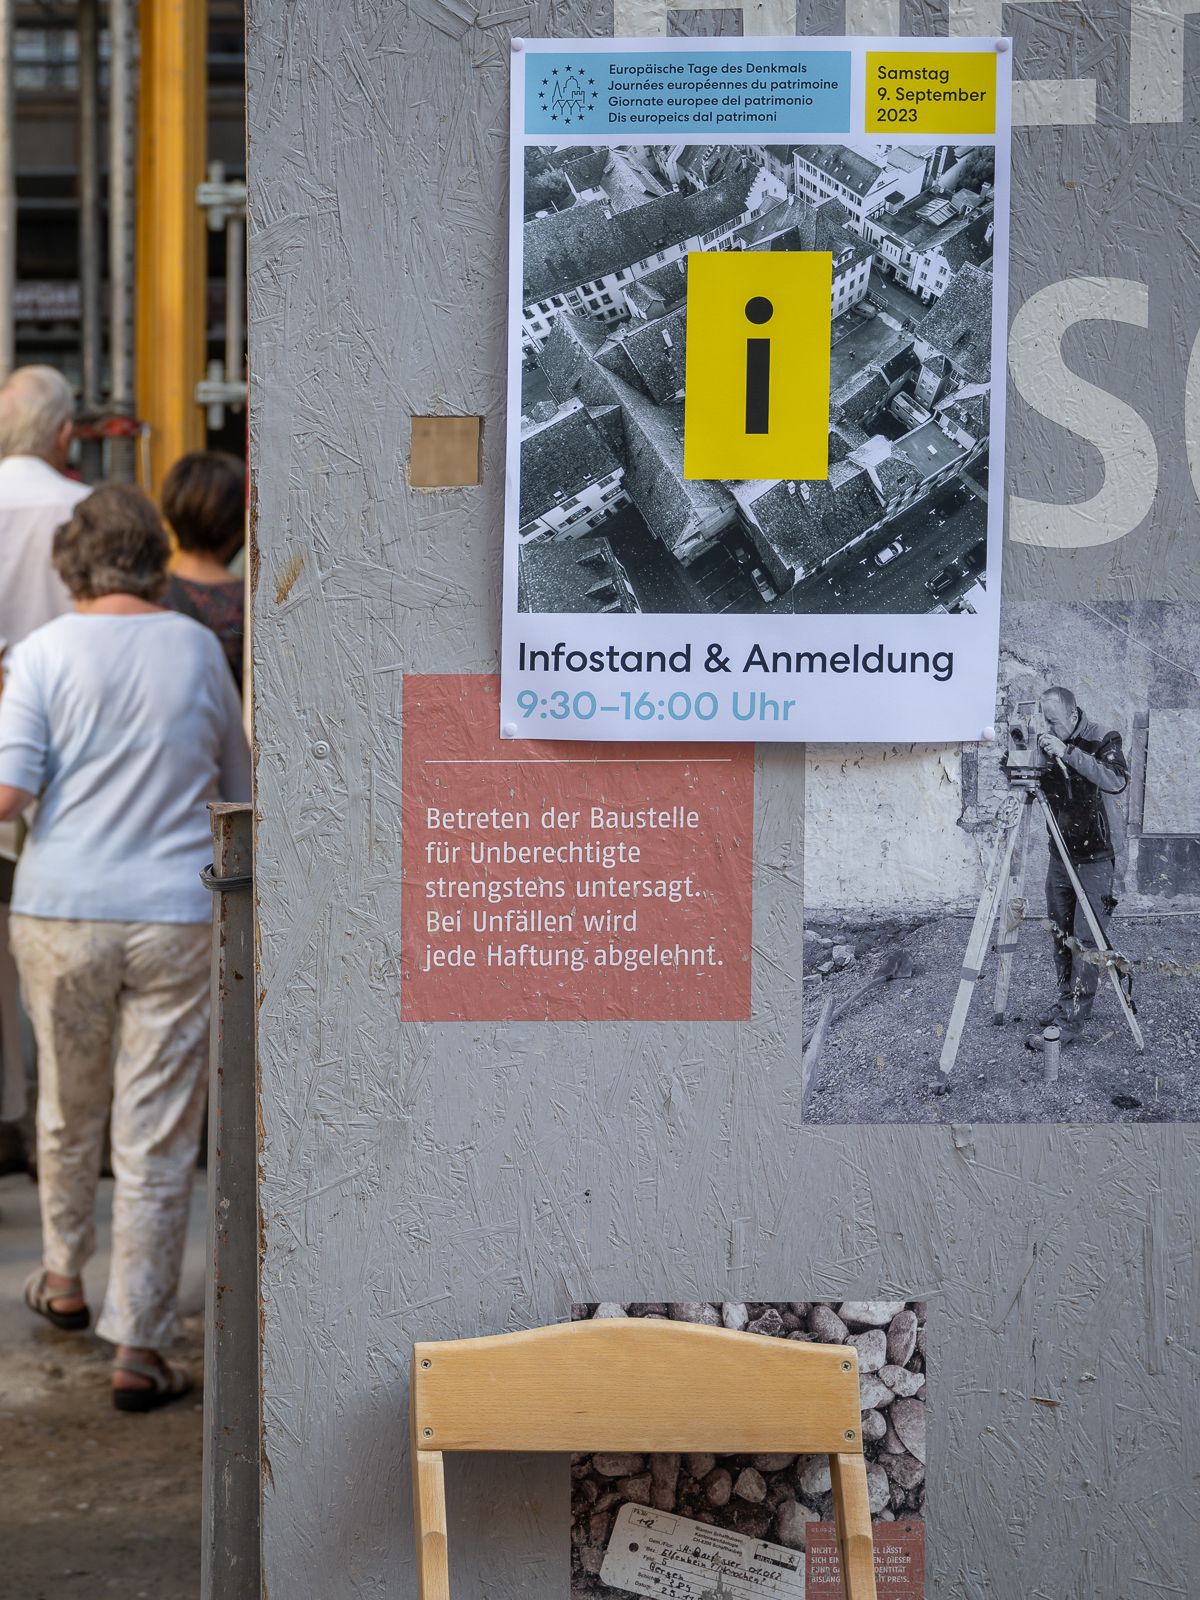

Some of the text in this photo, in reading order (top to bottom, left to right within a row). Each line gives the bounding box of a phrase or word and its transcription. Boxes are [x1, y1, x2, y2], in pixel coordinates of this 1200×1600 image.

[609, 62, 807, 77] Europäische Tage des Denkmals
[877, 65, 950, 84] Samstag
[607, 78, 839, 93] Journées européennes du patrimoine
[877, 85, 987, 105] 9. September
[608, 94, 813, 109] Giornate europee del patrimonio
[608, 111, 777, 125] Dis europeics dal patrimoni
[876, 108, 918, 123] 2023
[519, 642, 955, 682] Infostand & Anmeldung
[516, 688, 797, 721] 9:30–16:00 Uhr
[427, 806, 699, 830] Betreten der Baustelle
[425, 840, 641, 869] für Unberechtigte
[425, 876, 701, 905] strengstens untersagt.
[426, 909, 637, 933] Bei Unfällen wird
[423, 942, 723, 973] jede Haftung abgelehnt.
[882, 1544, 903, 1554] LÄSST
[811, 1556, 827, 1564] SICH
[887, 1556, 912, 1564] DIESER
